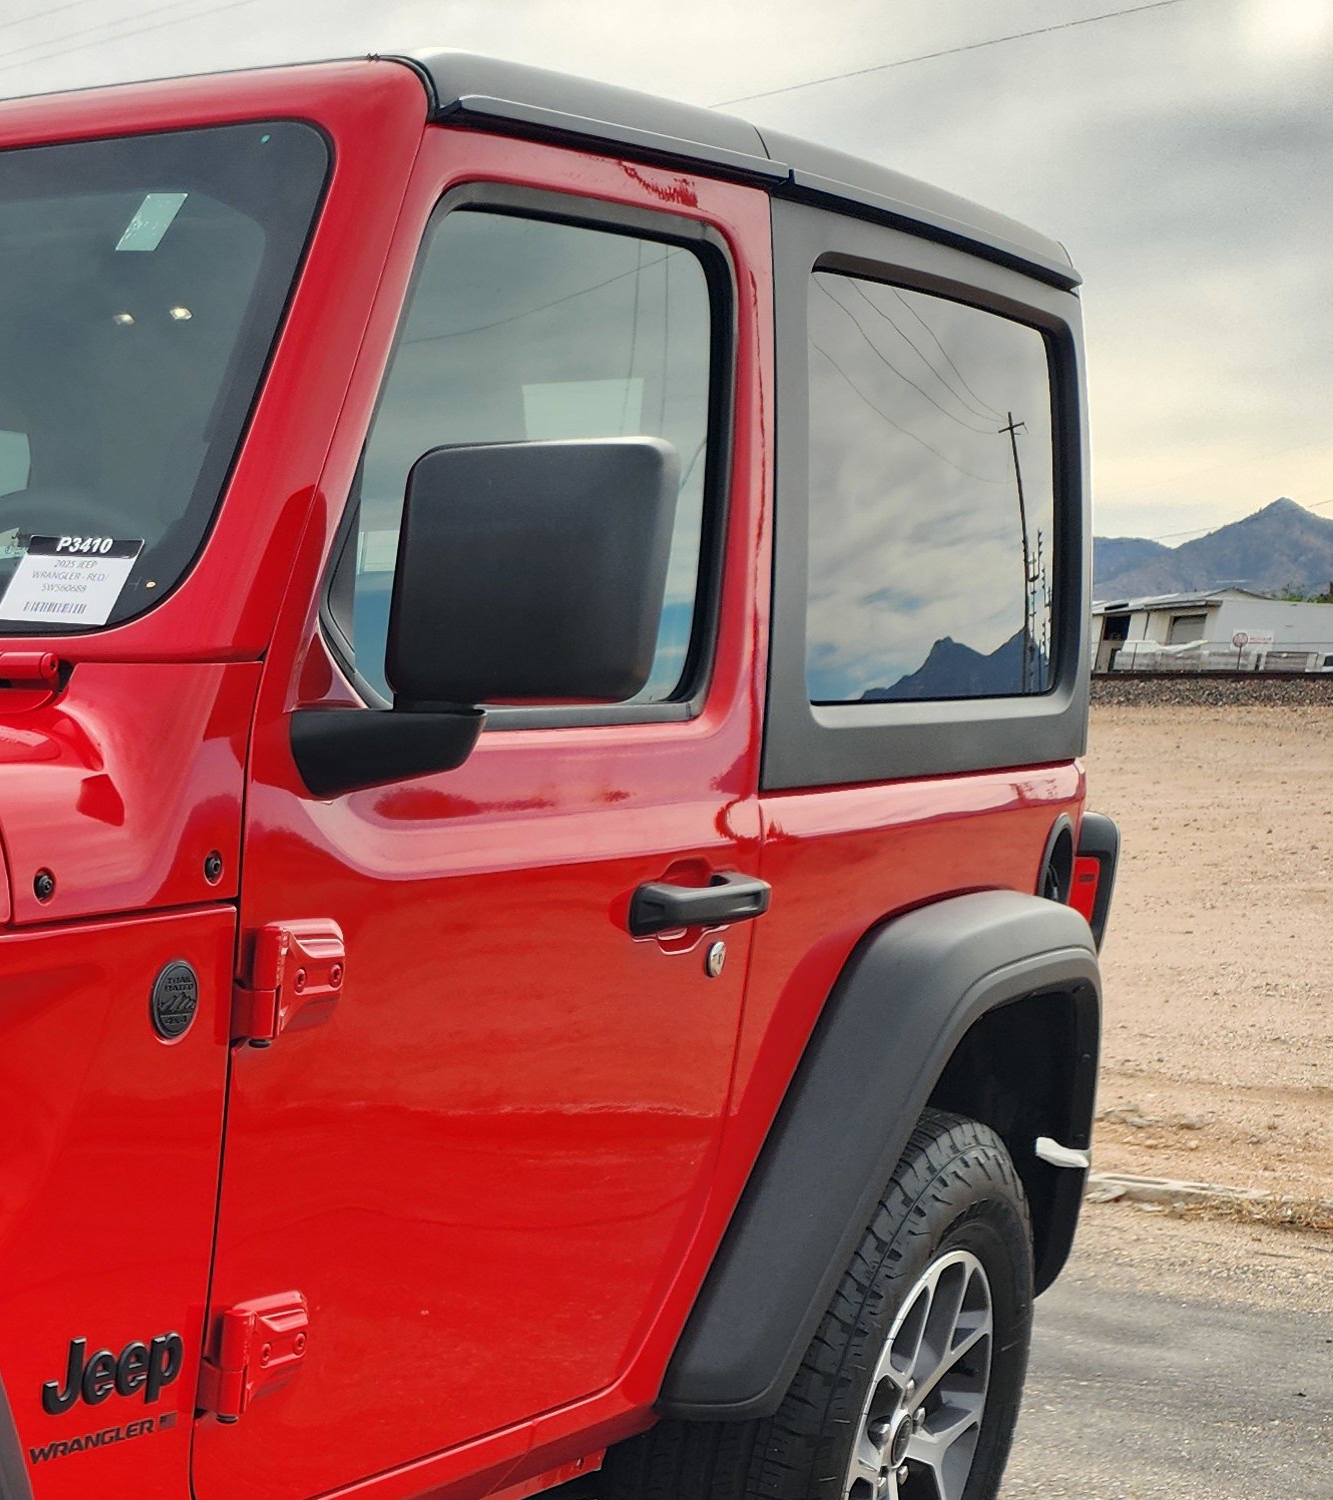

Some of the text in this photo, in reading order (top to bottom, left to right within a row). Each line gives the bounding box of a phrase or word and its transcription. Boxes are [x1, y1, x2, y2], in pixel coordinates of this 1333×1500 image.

[56, 536, 113, 554] P3410
[54, 559, 98, 569] 2025 JEEP
[32, 570, 81, 581] WRANGLER
[41, 1331, 183, 1416] Jeep
[29, 1418, 155, 1465] WRANGLER
